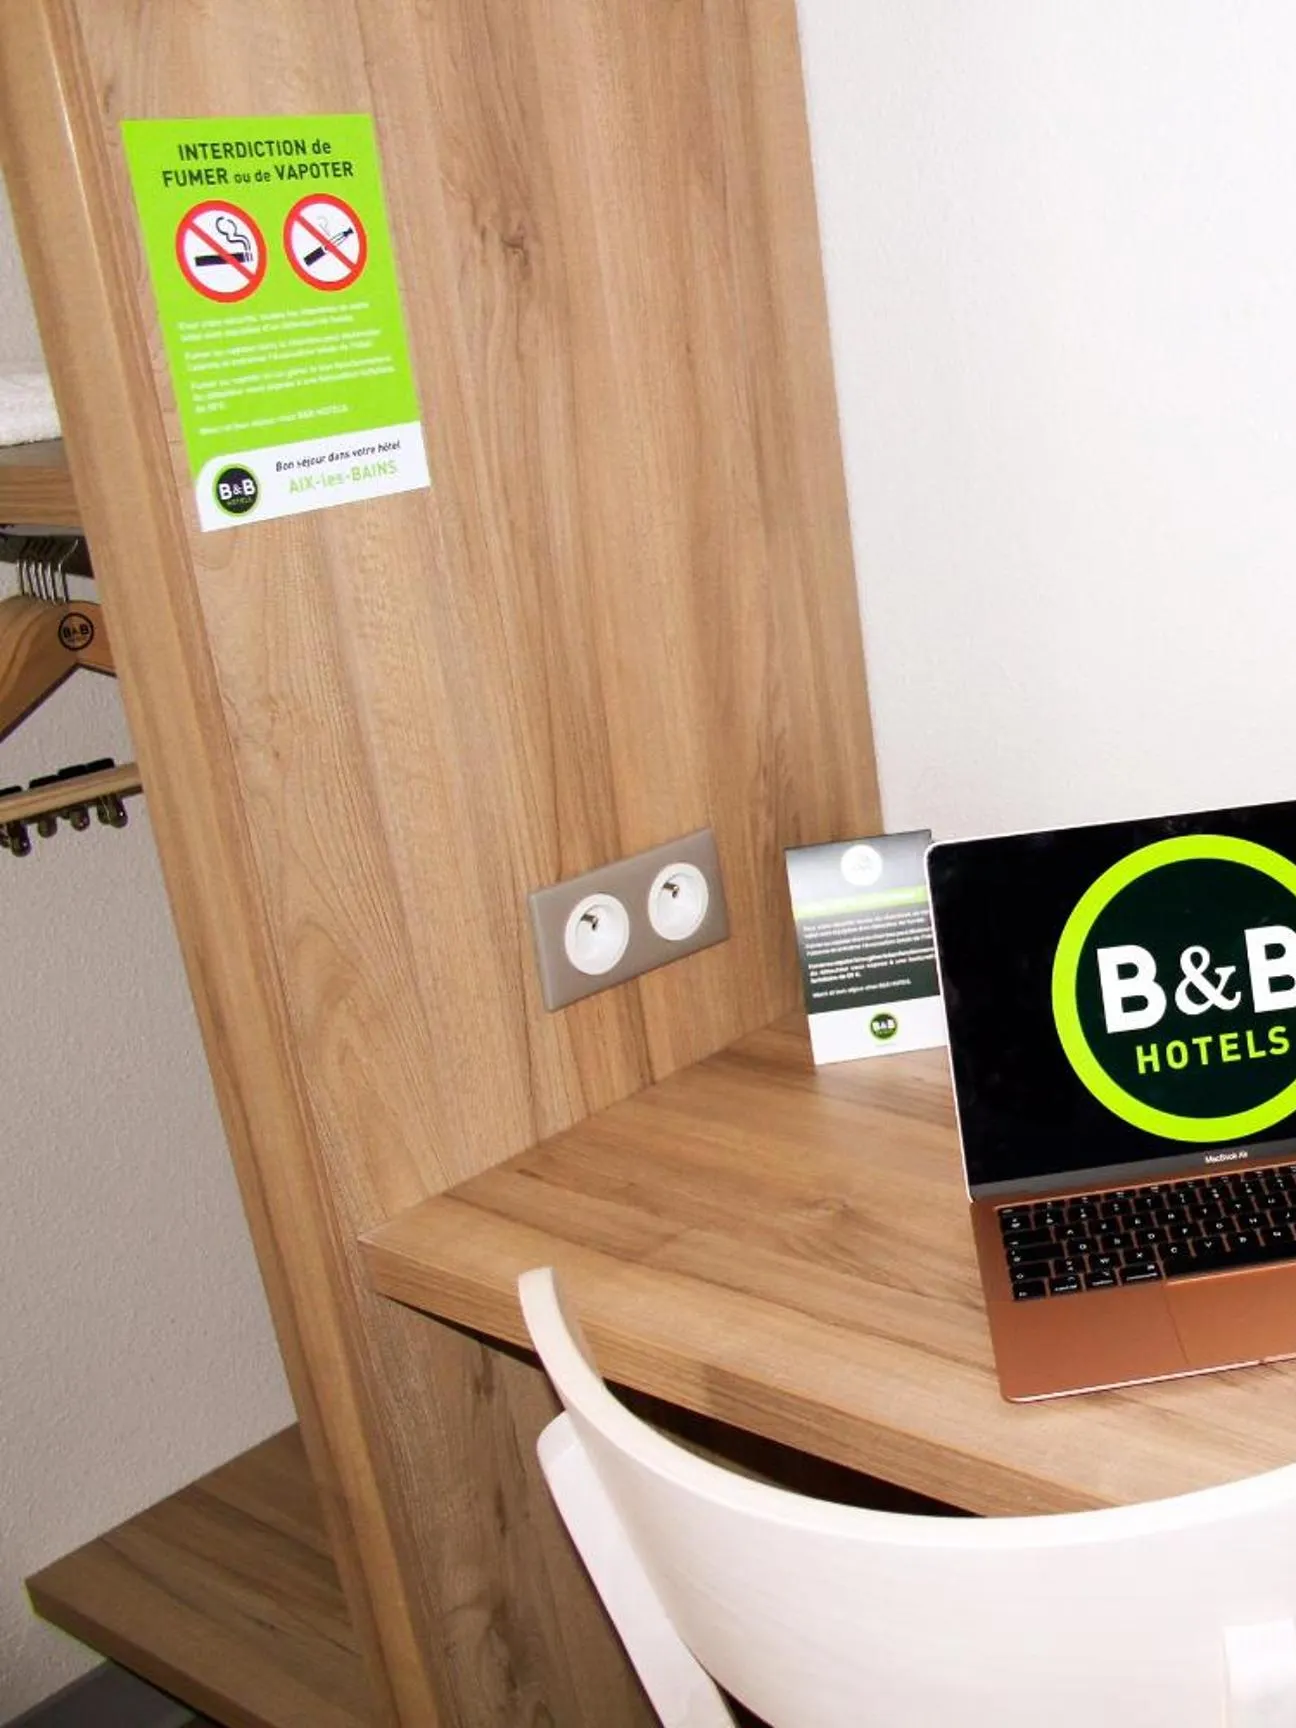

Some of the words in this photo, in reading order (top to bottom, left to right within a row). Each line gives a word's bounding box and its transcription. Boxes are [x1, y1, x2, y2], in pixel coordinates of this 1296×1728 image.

[178, 139, 306, 161] INTERDICTION
[312, 139, 332, 155] de
[162, 168, 229, 188] FUMER
[234, 174, 252, 185] ou
[255, 169, 271, 183] de
[275, 161, 354, 181] VAPOTER
[275, 460, 295, 472] Bon
[328, 451, 350, 463] dans
[352, 446, 375, 457] votre
[377, 440, 401, 454] hôtel
[219, 478, 256, 500] B&B
[288, 460, 399, 494] AIX-les-BAINS
[1136, 1026, 1290, 1074] HOTELS
